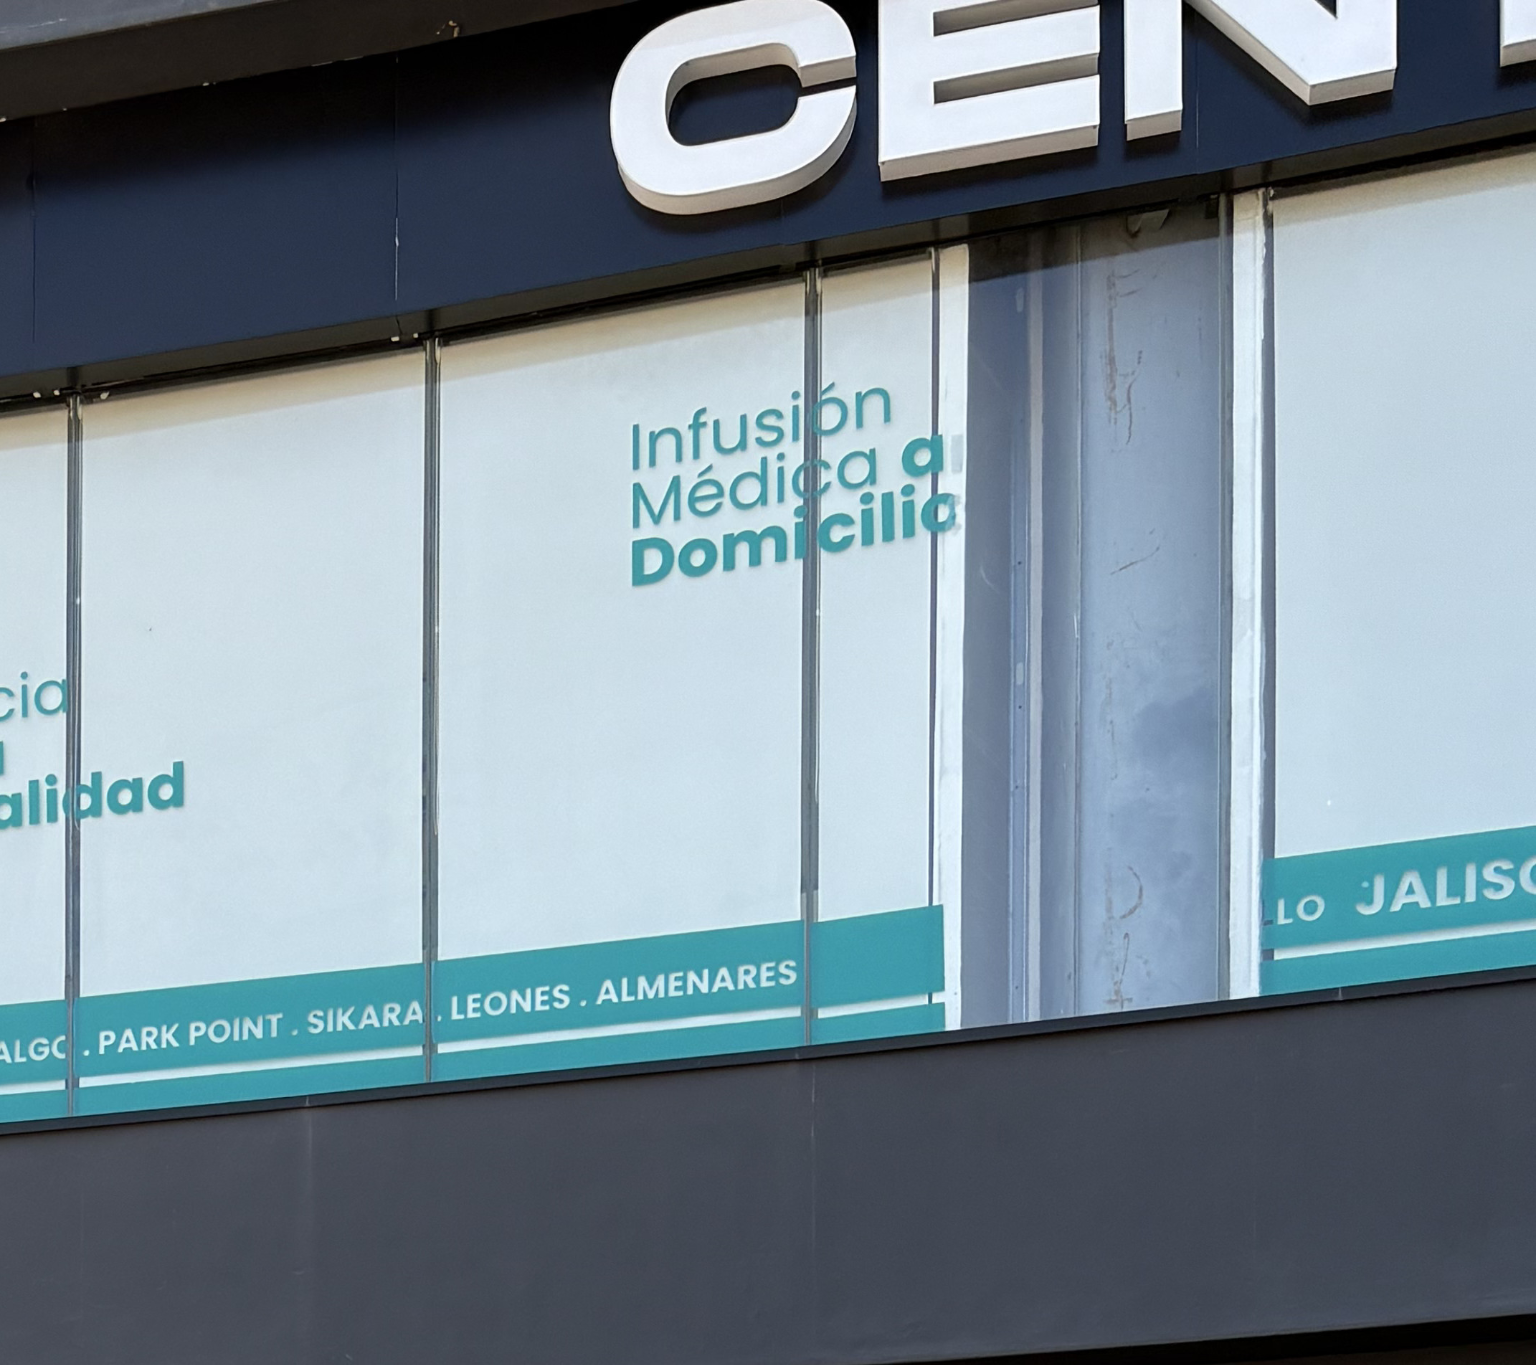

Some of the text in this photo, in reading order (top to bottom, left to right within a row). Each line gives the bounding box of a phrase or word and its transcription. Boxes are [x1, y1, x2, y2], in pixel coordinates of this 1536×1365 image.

[610, 0, 1536, 215] CEN
[631, 381, 892, 472] Infusión
[631, 434, 944, 529] Médica a
[631, 483, 956, 588] Domicilio
[1262, 895, 1325, 925] LO
[98, 1022, 180, 1055] PARK
[188, 1013, 284, 1046] POINT
[307, 1000, 424, 1034] SIKARA
[450, 984, 571, 1021] LEONES
[596, 960, 798, 1006] ALMENARES
